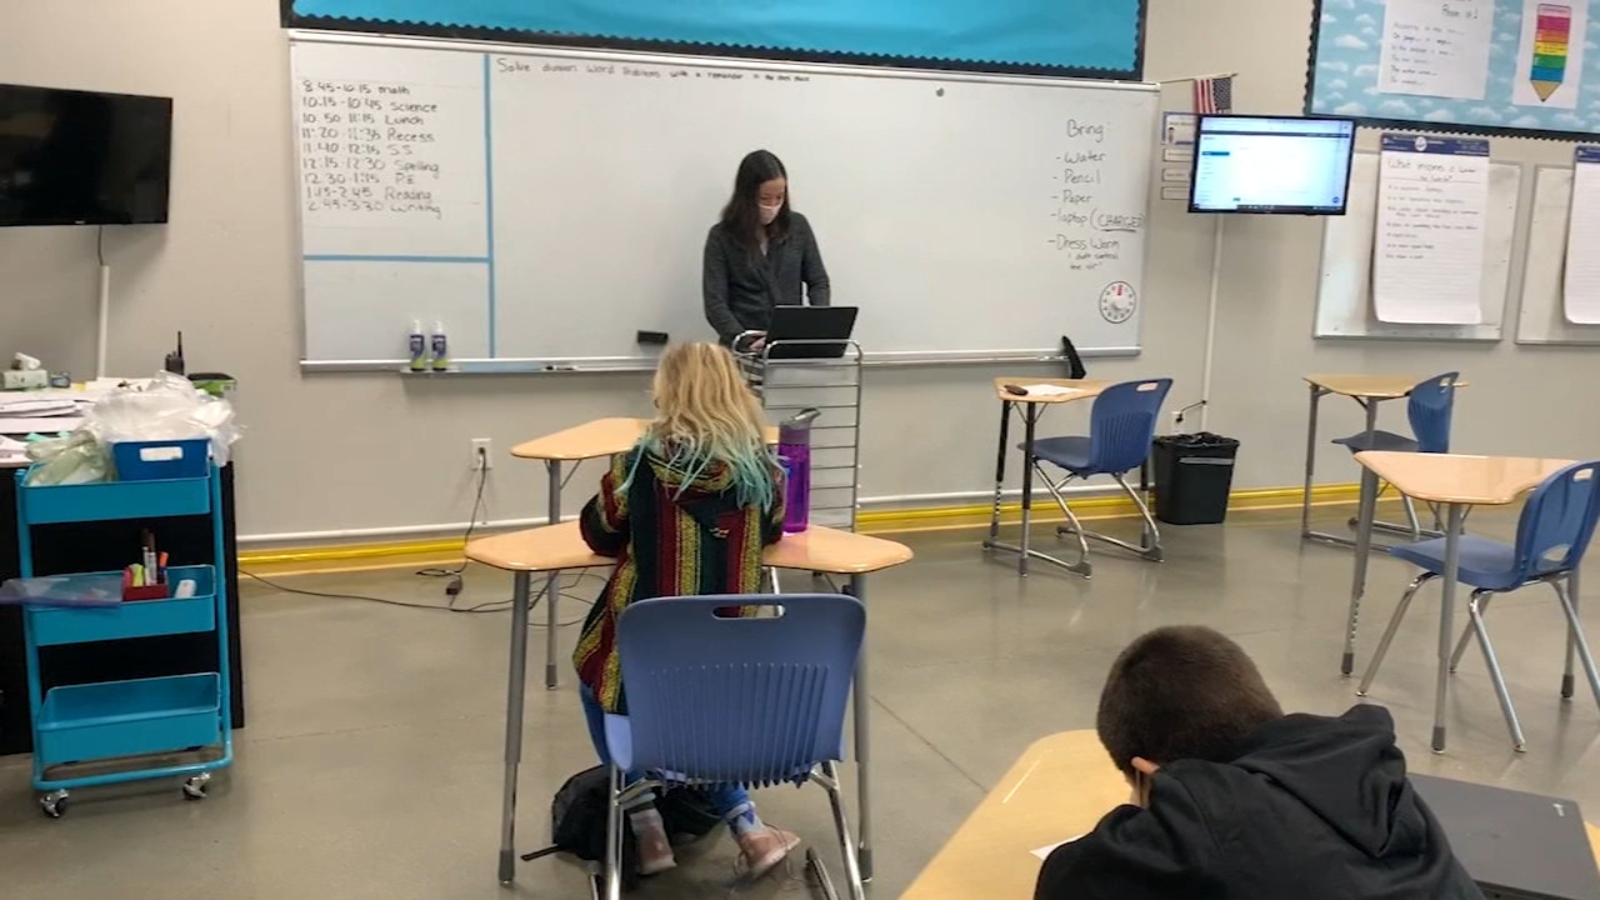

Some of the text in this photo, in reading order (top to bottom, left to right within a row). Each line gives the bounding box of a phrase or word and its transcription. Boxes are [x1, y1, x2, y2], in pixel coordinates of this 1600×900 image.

[496, 57, 531, 72] Solve
[389, 101, 438, 113] Science
[384, 114, 425, 125] Lunch
[387, 127, 436, 143] Recess
[1066, 118, 1105, 143] Bring
